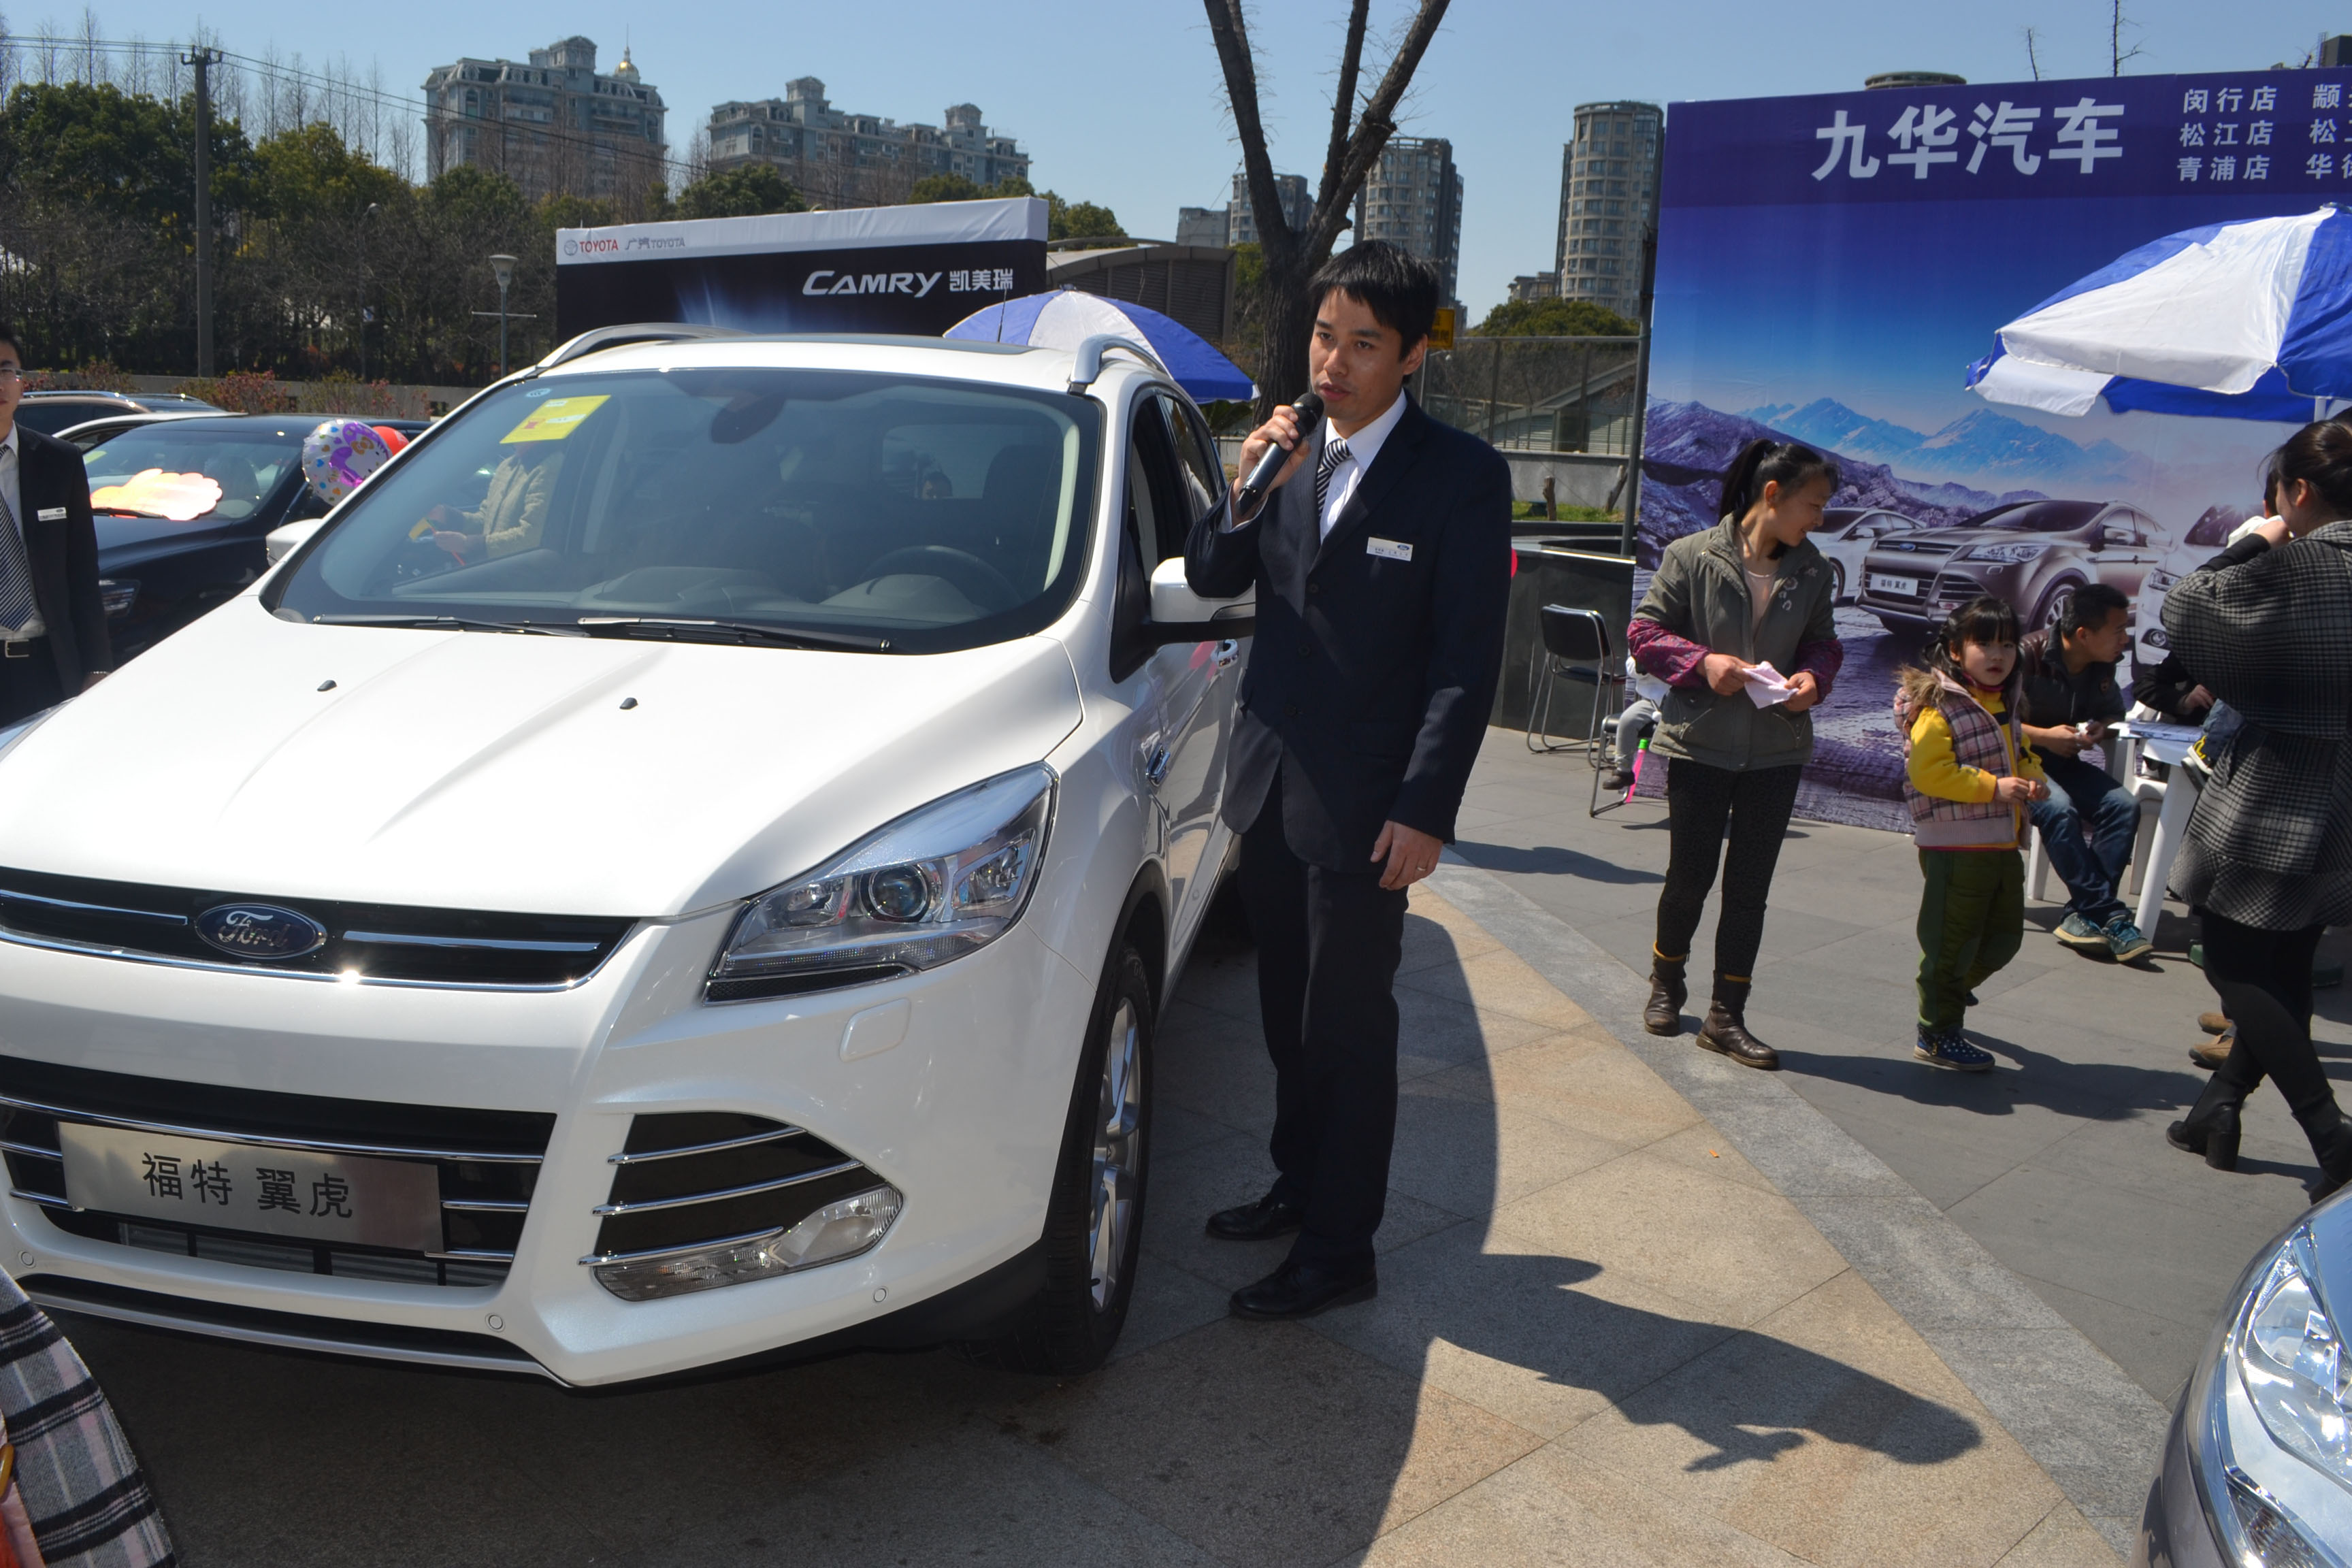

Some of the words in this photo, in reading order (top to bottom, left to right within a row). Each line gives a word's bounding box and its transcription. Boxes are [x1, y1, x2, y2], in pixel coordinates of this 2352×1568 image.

[2183, 86, 2277, 114] 闵行店
[2313, 84, 2352, 109] 颛
[1811, 97, 2125, 180] 九华汽车
[2179, 120, 2273, 147] 松江店
[2309, 118, 2352, 144] 松
[2177, 154, 2270, 182] 青浦店
[580, 240, 619, 252] TOYOTA
[802, 270, 943, 298] CAMRY
[949, 268, 1013, 291] 凯美瑞
[218, 911, 289, 947] Ford
[142, 1152, 233, 1206] 福特
[255, 1167, 353, 1218] 翼虎
